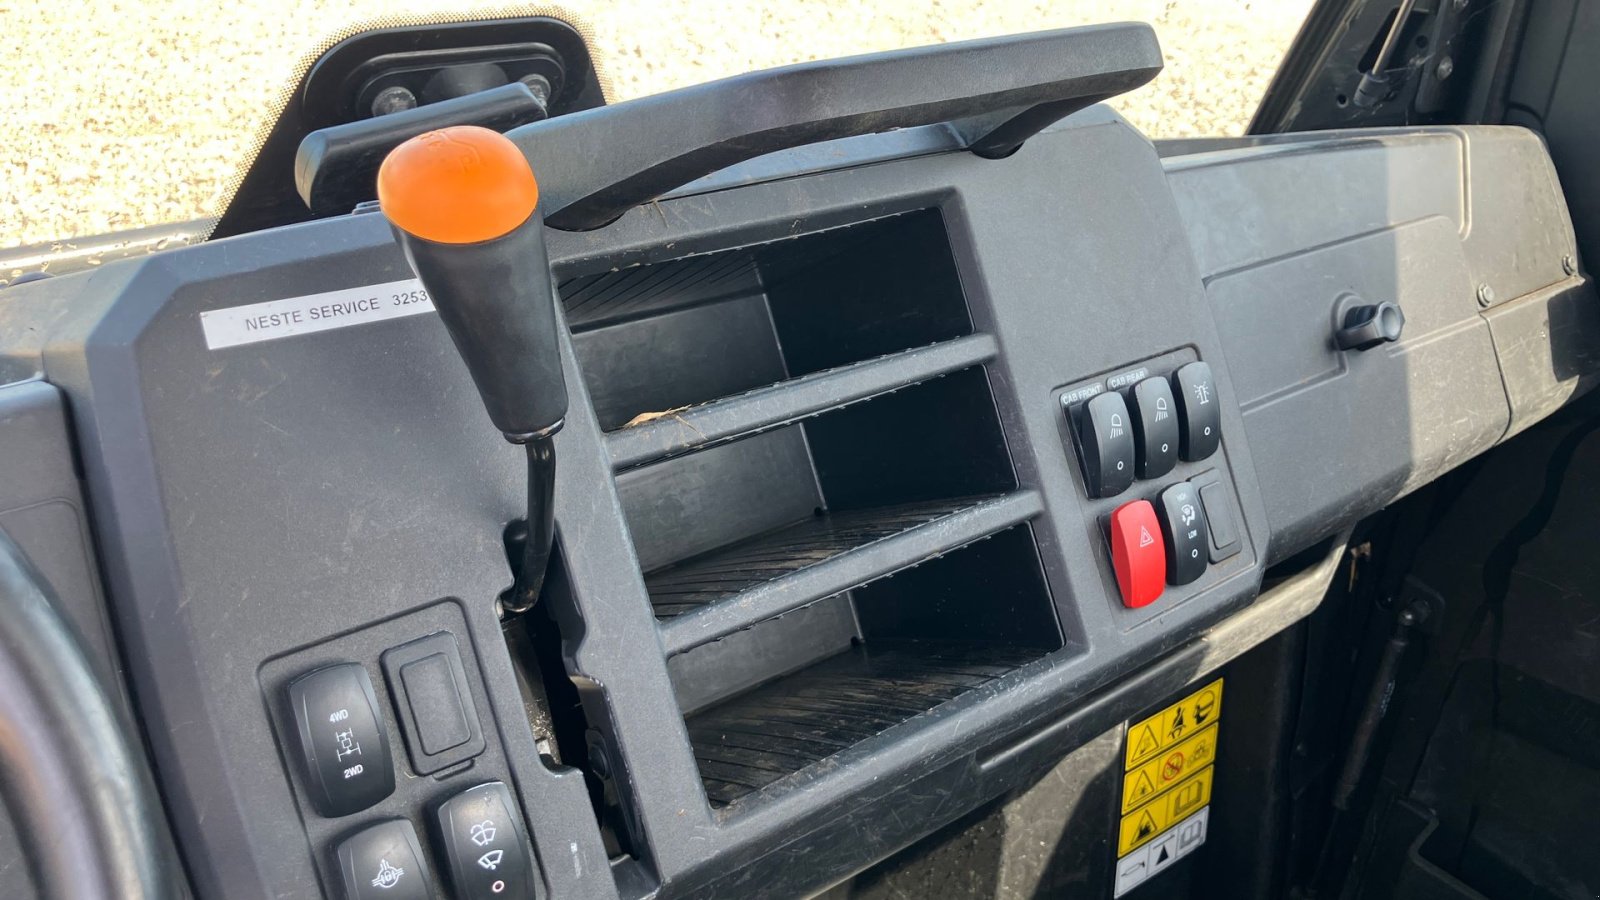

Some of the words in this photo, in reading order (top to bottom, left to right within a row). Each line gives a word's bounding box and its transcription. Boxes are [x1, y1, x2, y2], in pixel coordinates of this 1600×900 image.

[245, 309, 303, 331] NESTE
[310, 297, 381, 320] SERVICE
[1111, 376, 1126, 388] CAB
[1126, 370, 1145, 383] REAR
[1062, 393, 1078, 405] CAB
[1078, 385, 1101, 399] FRONT
[1187, 529, 1198, 540] LOW
[329, 708, 349, 723] 4WD
[343, 764, 364, 779] 2WD
